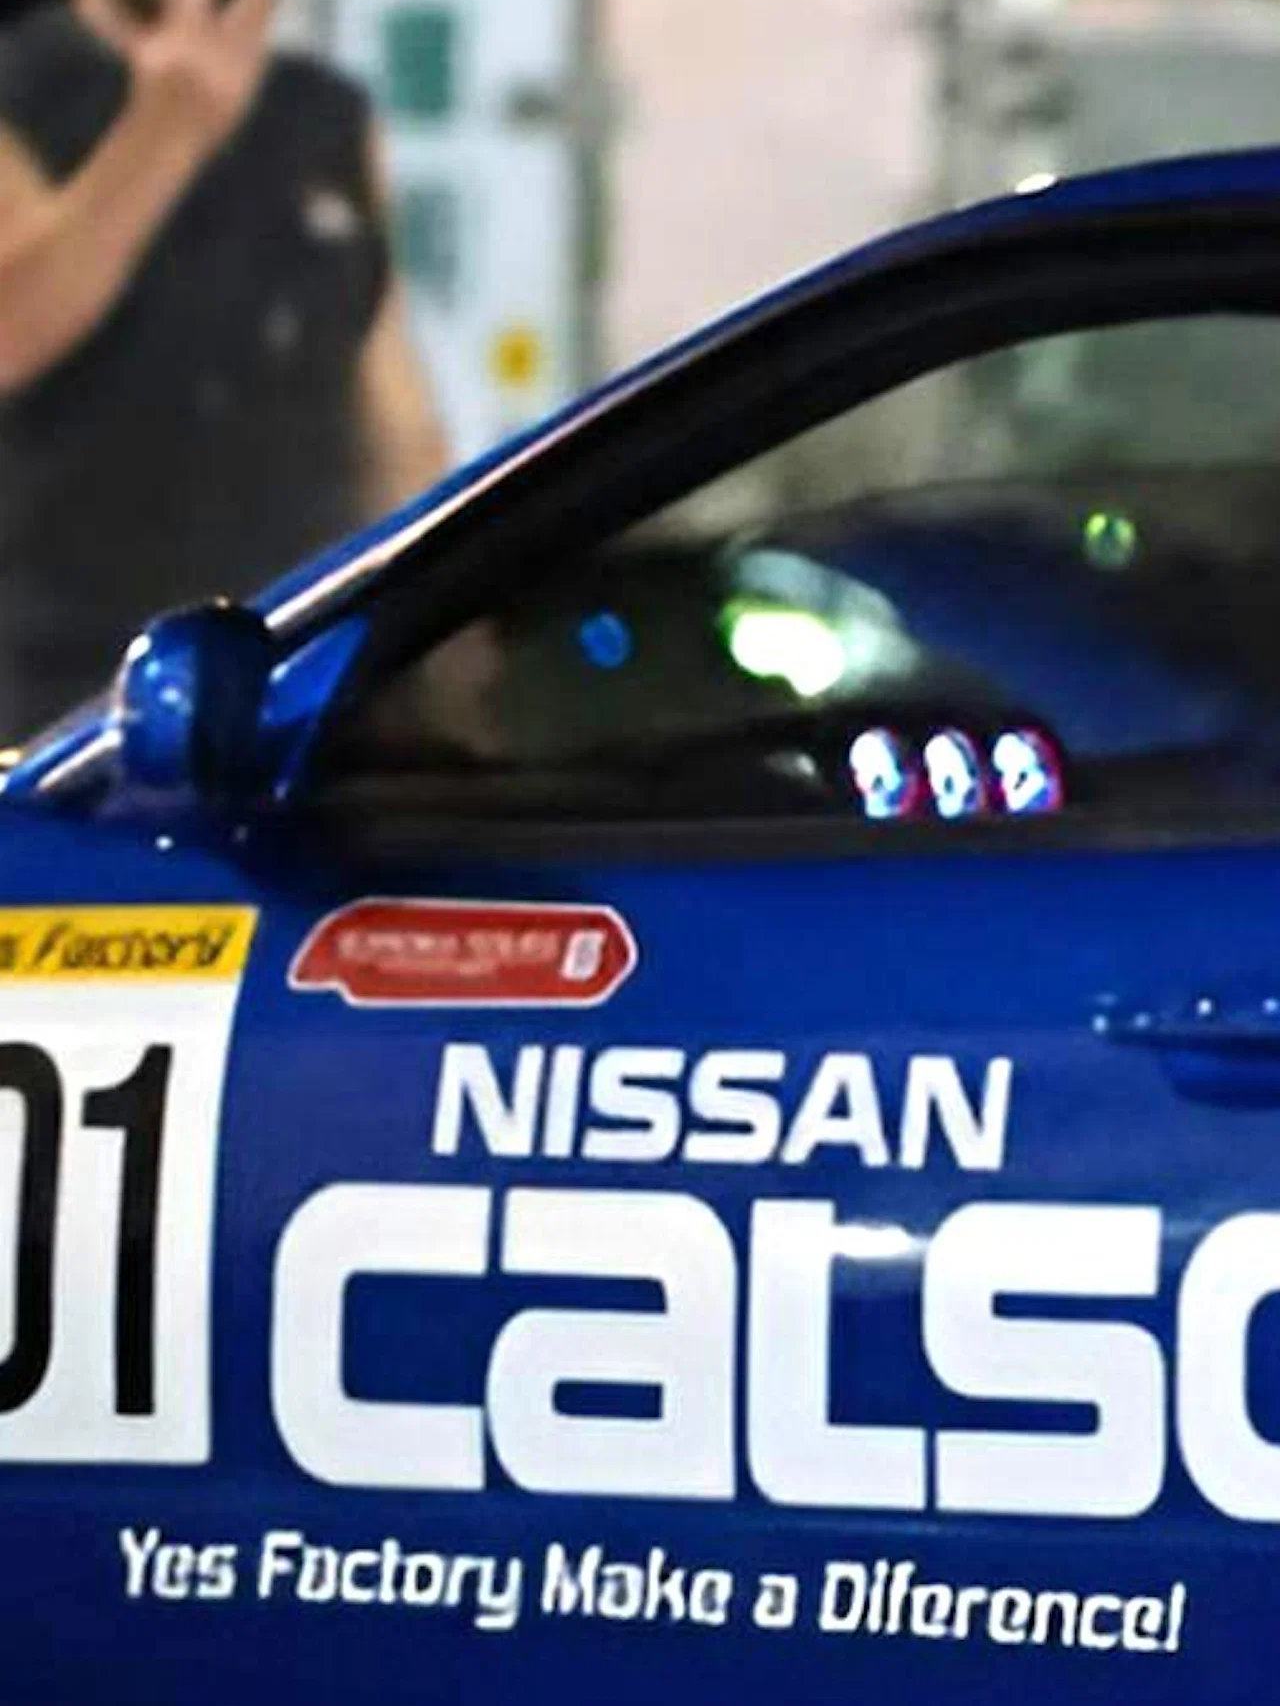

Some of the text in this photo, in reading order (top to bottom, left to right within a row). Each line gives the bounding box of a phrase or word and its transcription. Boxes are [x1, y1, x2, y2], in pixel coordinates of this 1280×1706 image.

[433, 1043, 1012, 1173] NISSAN
[118, 1527, 238, 1600] Yes
[256, 1529, 524, 1631] Factory
[539, 1542, 734, 1627] Make
[751, 1573, 799, 1630] a
